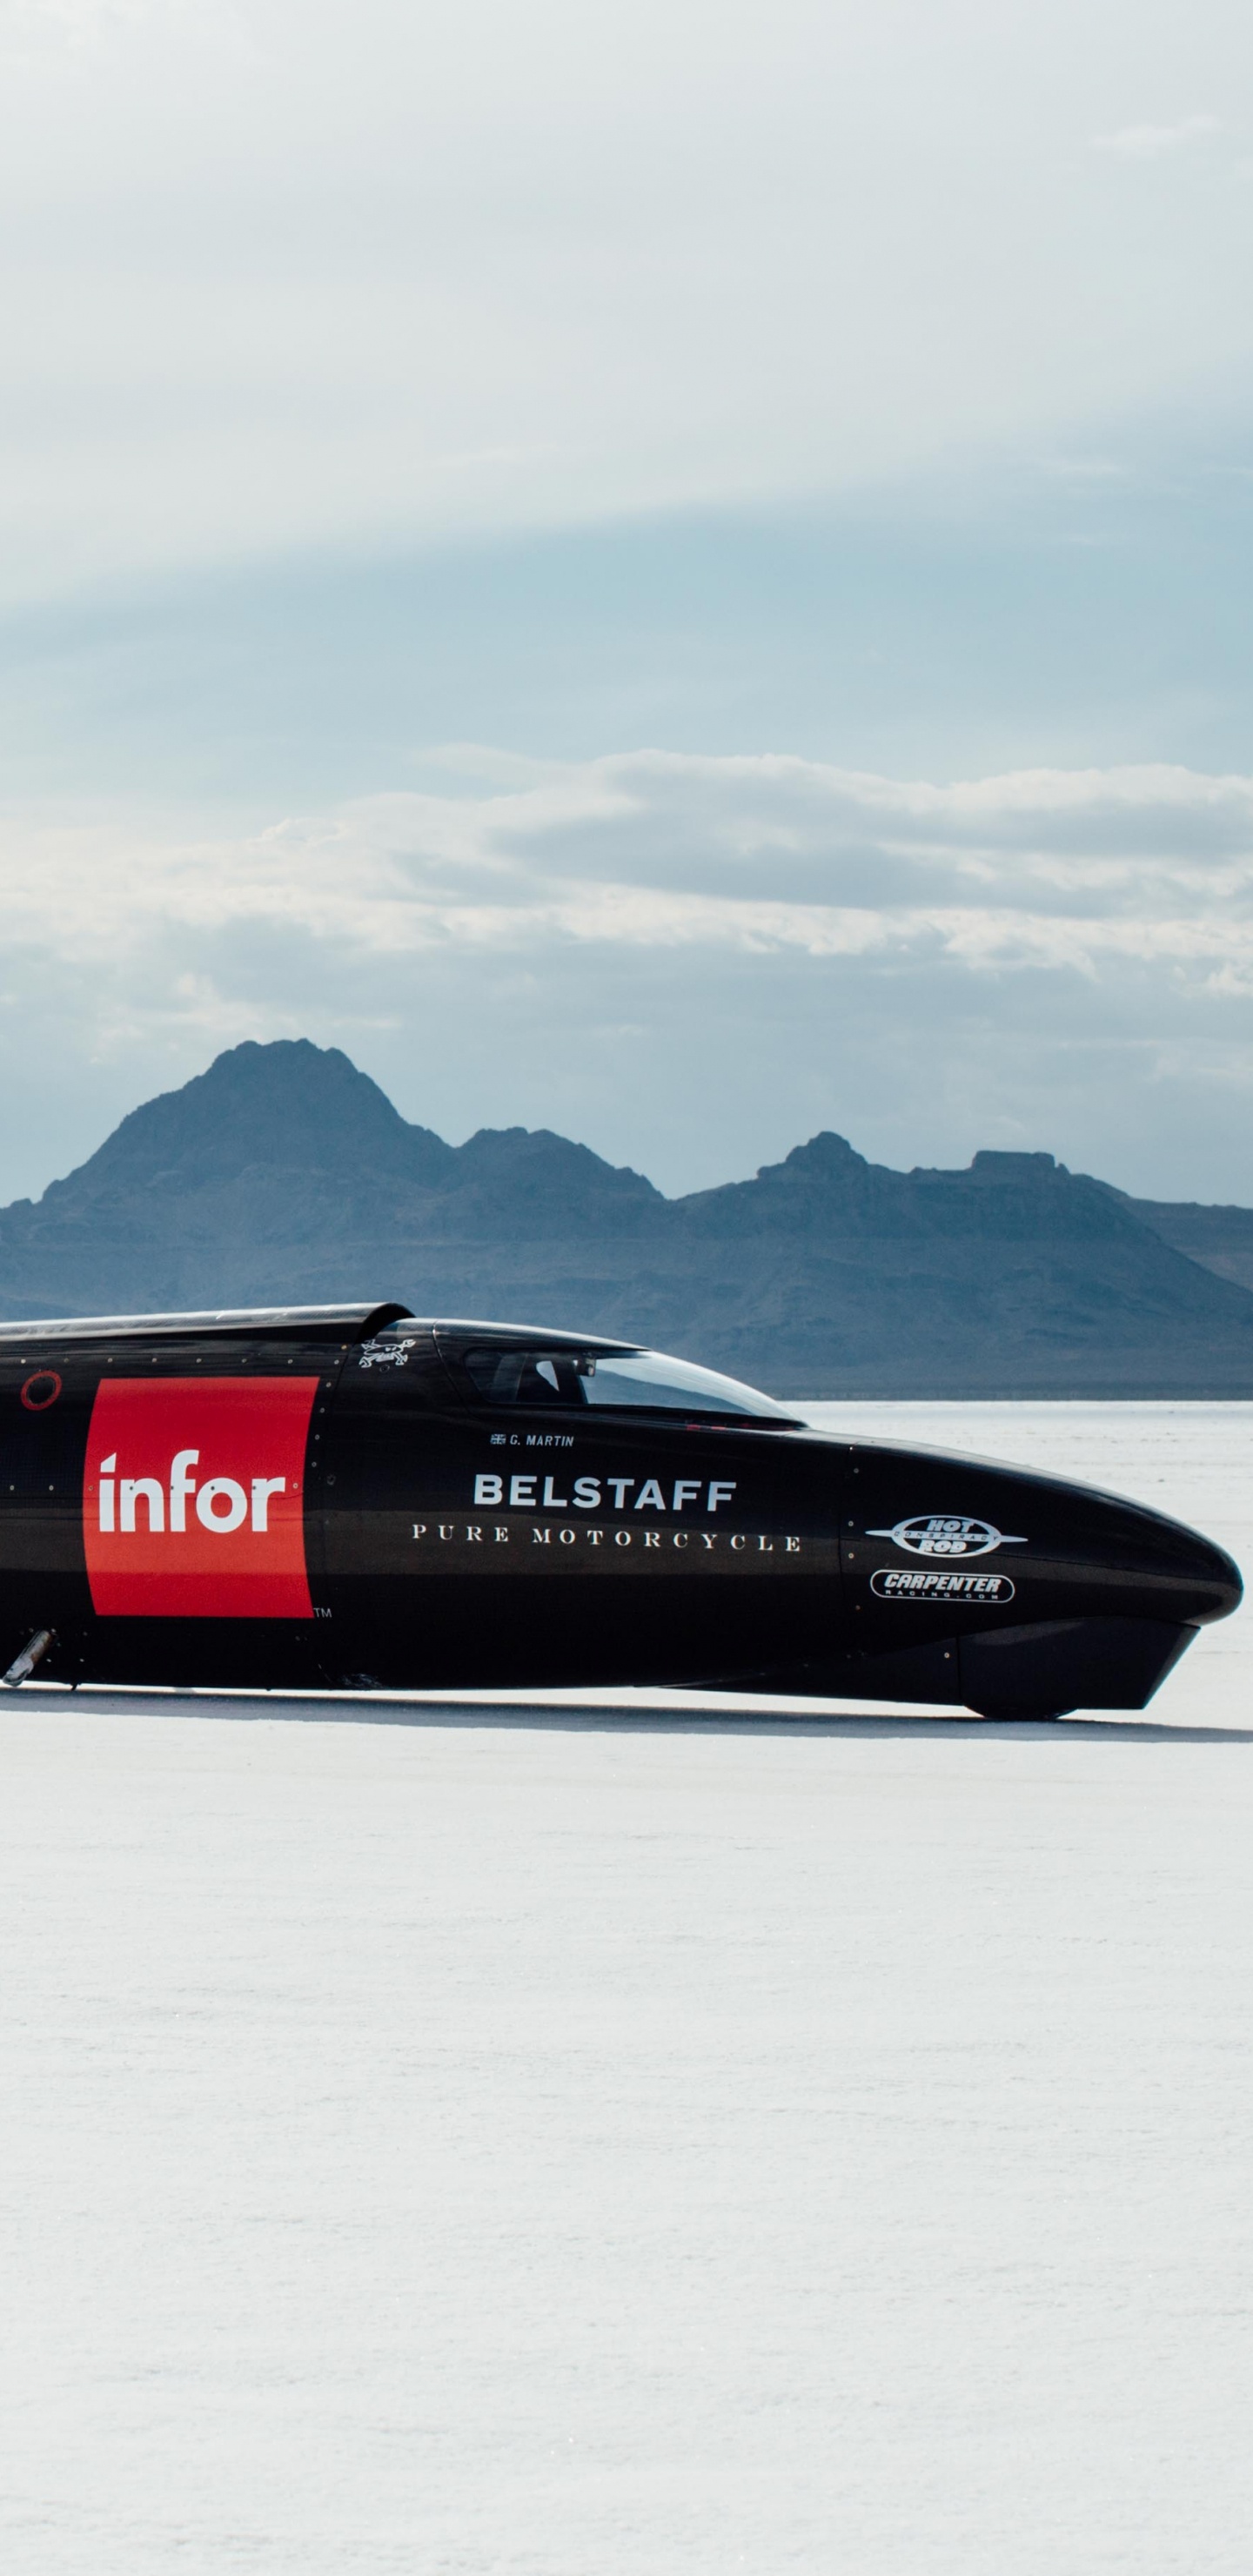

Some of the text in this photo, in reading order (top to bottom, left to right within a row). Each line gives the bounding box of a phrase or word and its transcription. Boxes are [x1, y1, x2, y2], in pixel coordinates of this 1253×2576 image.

[509, 1434, 575, 1448] G. MARTIN
[98, 1448, 286, 1534] infor
[473, 1473, 737, 1513] BELSTAFF
[926, 1519, 976, 1533] HOT
[412, 1523, 801, 1553] PURE MOTORCYCLE
[894, 1530, 999, 1542] CONSPIRACY
[918, 1539, 968, 1553] ROD
[883, 1573, 1002, 1593] CARPENTER
[885, 1589, 999, 1600] RACING.COM
[312, 1607, 332, 1619] TM
